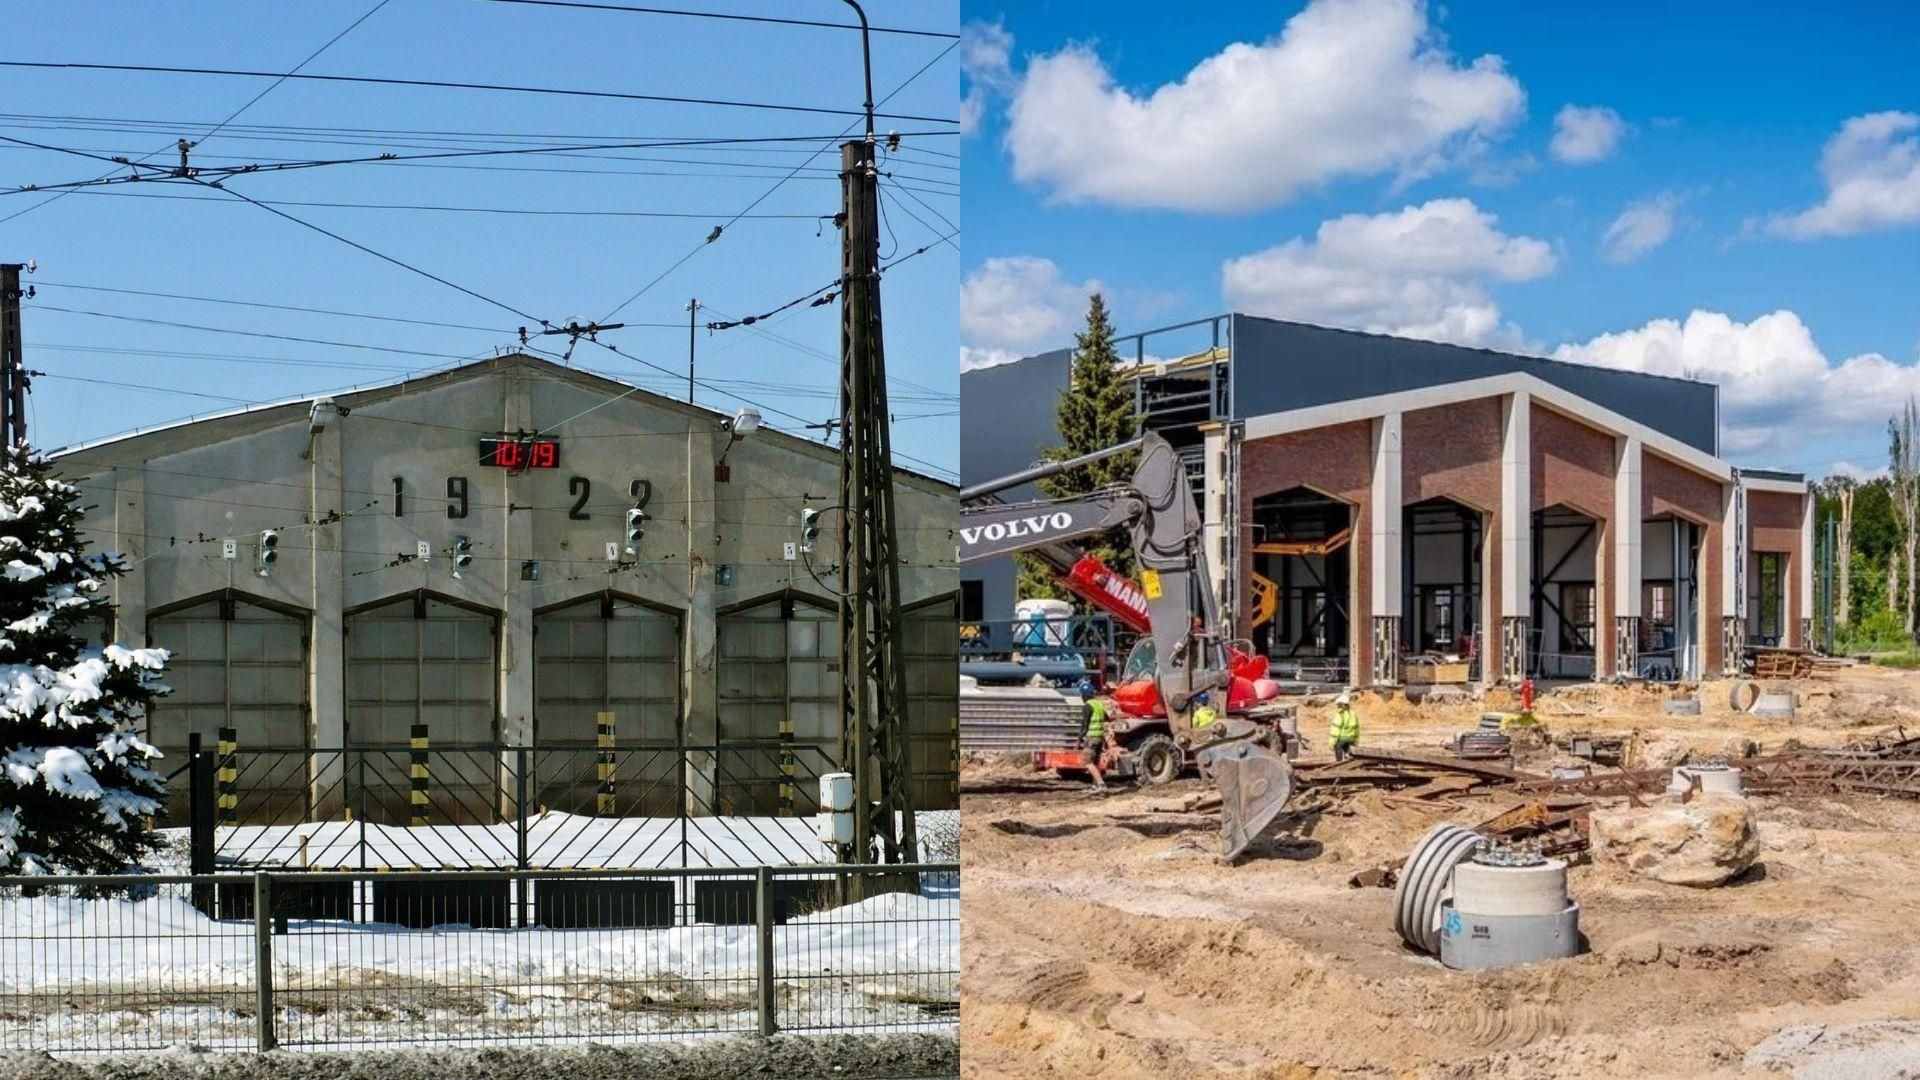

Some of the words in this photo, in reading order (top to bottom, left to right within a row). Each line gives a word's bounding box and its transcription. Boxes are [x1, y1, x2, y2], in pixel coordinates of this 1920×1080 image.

[496, 441, 554, 467] 10:19
[960, 512, 1073, 545] VOLVO
[1104, 574, 1150, 618] MANI
